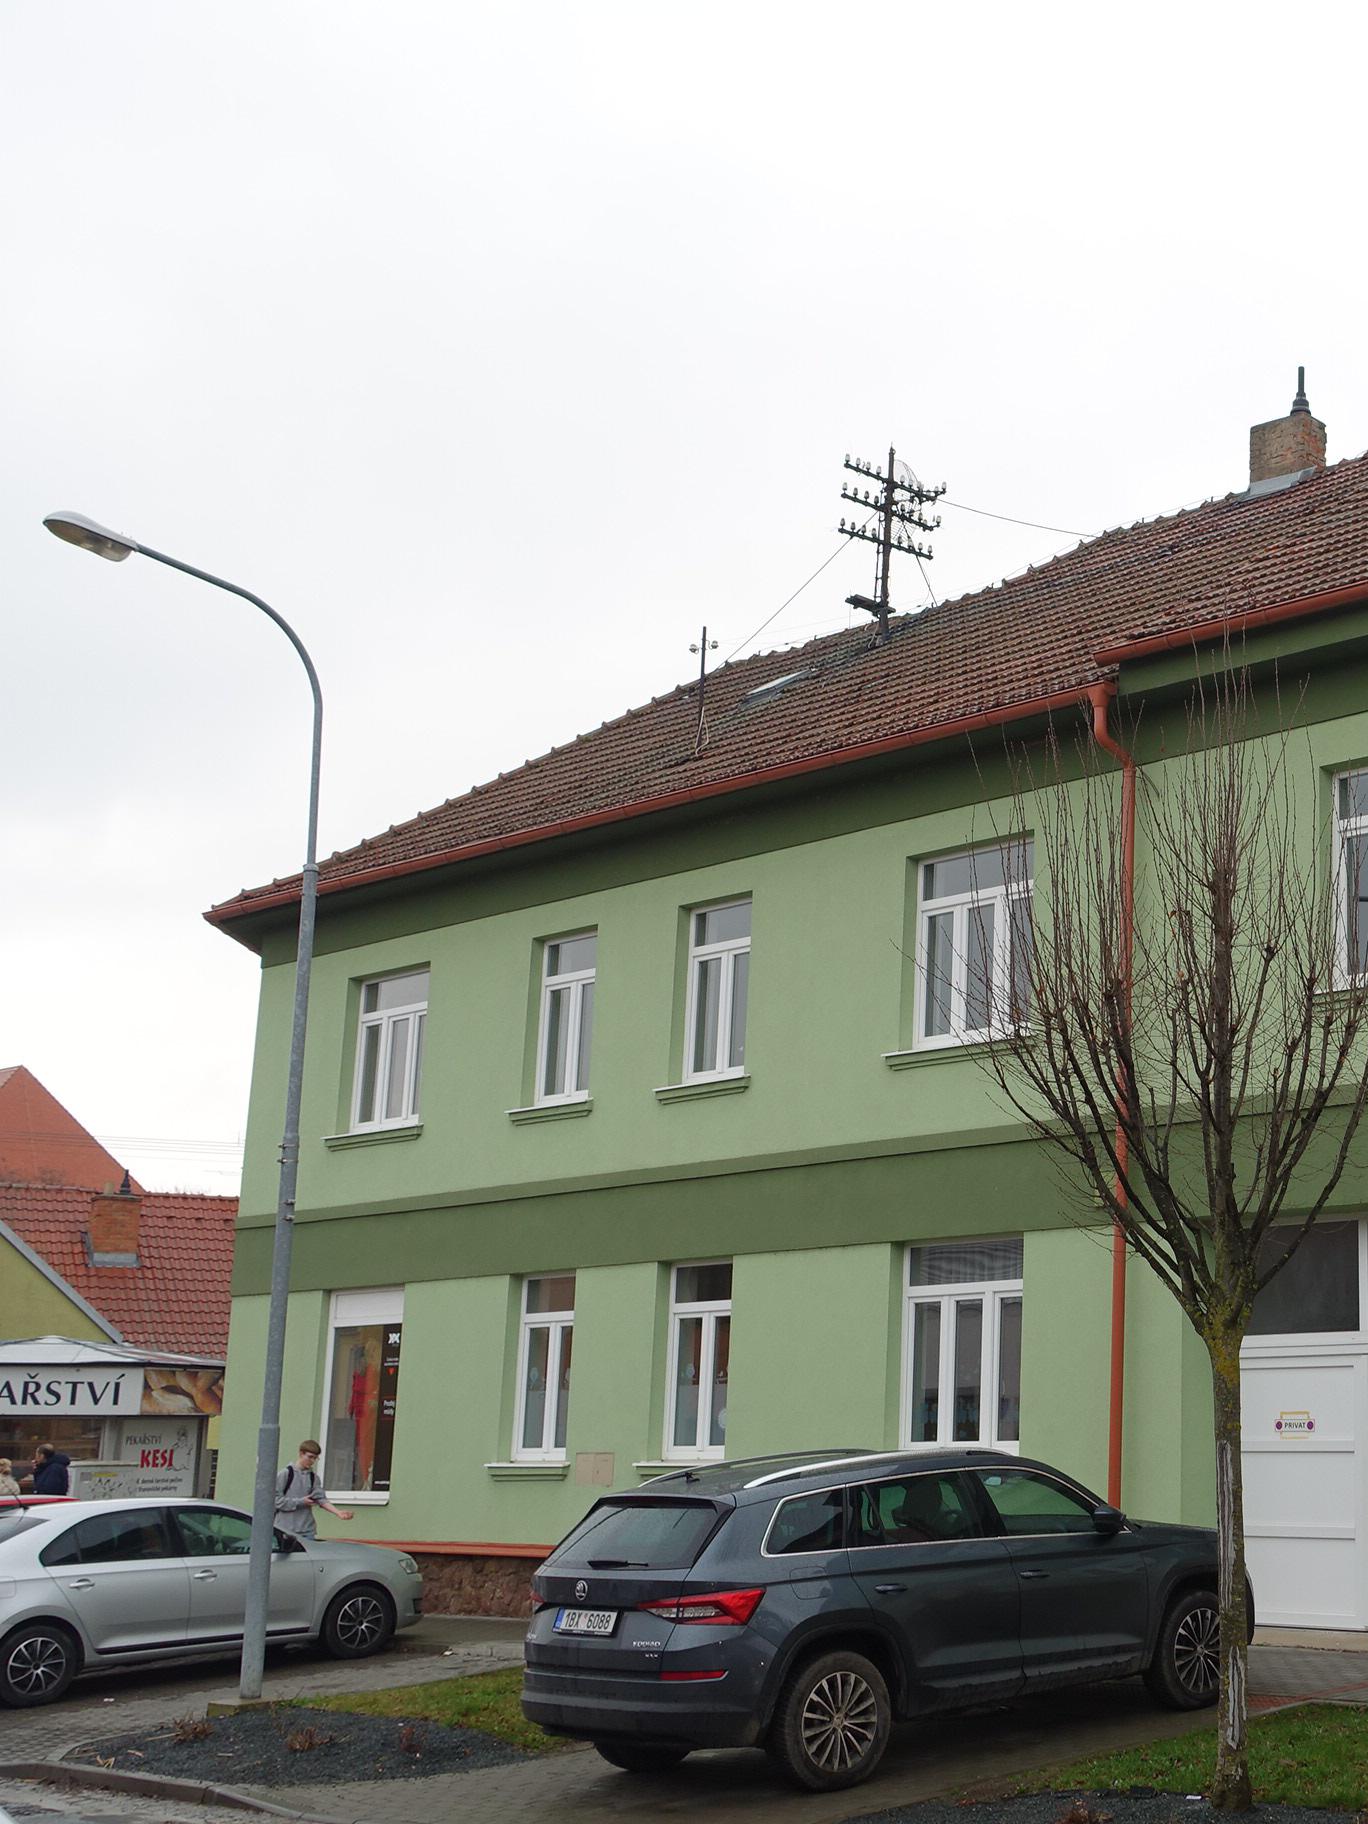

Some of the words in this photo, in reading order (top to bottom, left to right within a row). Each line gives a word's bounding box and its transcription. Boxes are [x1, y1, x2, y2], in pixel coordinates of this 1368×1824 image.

[125, 1433, 163, 1446] PEKAŘSTVÍ
[139, 1449, 175, 1469] KESI
[564, 1611, 582, 1629] 1BX
[586, 1613, 612, 1630] 6088
